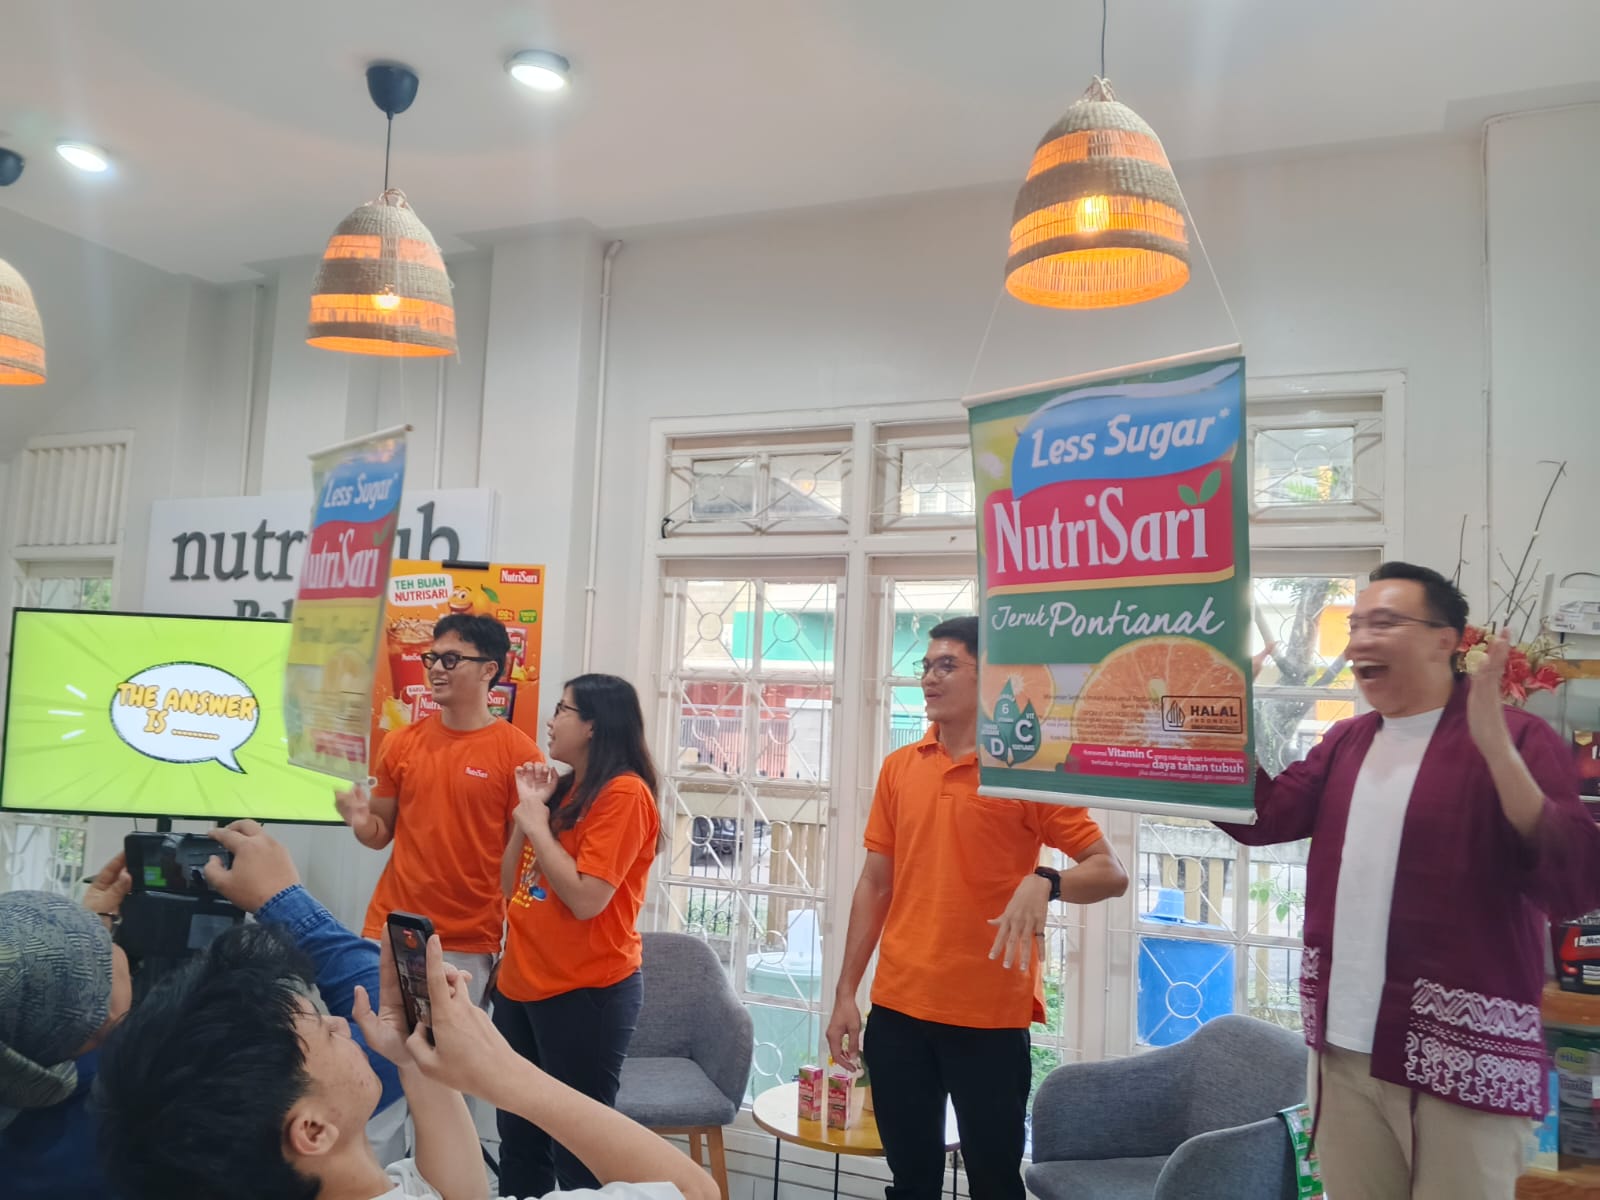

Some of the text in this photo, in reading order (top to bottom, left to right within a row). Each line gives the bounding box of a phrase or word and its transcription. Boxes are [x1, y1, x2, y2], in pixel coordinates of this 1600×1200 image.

[1031, 427, 1096, 469] Less
[323, 478, 353, 508] Less
[992, 487, 1208, 573] NutriSari
[394, 577, 446, 590] TEH BUAH
[395, 589, 449, 602] NUTRISARI
[991, 597, 1225, 637] Jeruk Pontianak
[117, 682, 257, 721] THE ANSWER
[1001, 704, 1009, 714] 6
[1190, 705, 1237, 717] HALAL
[144, 708, 169, 734] IS
[1015, 719, 1033, 743] C
[990, 738, 1005, 756] D
[1108, 747, 1144, 760] Vitamin
[1146, 750, 1153, 759] C
[1152, 760, 1176, 771] daya
[1178, 761, 1208, 772] tahan
[1210, 762, 1244, 773] tubuh
